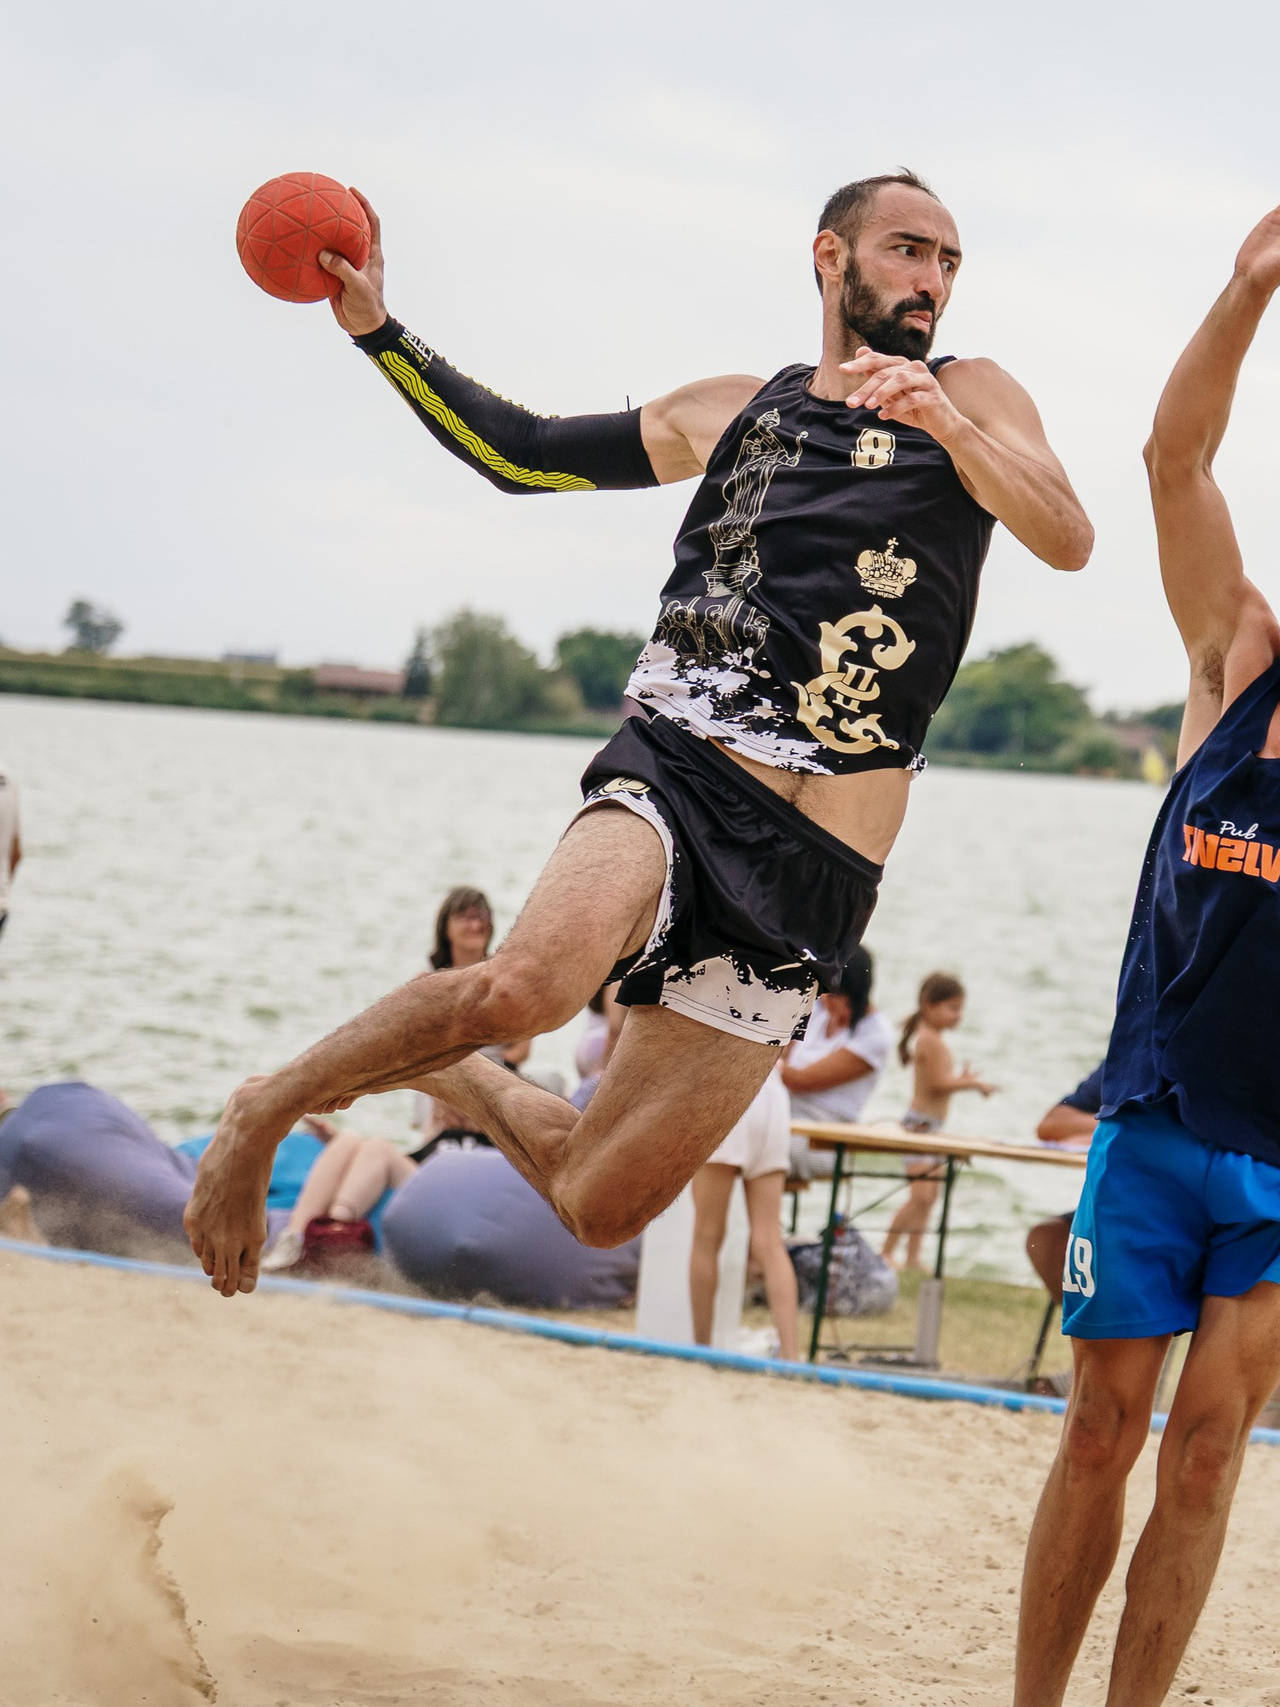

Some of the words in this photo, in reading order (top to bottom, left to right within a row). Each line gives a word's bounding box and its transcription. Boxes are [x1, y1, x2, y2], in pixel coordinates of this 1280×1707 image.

[402, 327, 435, 362] SELECT
[851, 427, 896, 470] 8
[1219, 820, 1259, 840] Pub
[1062, 1232, 1096, 1298] 19
